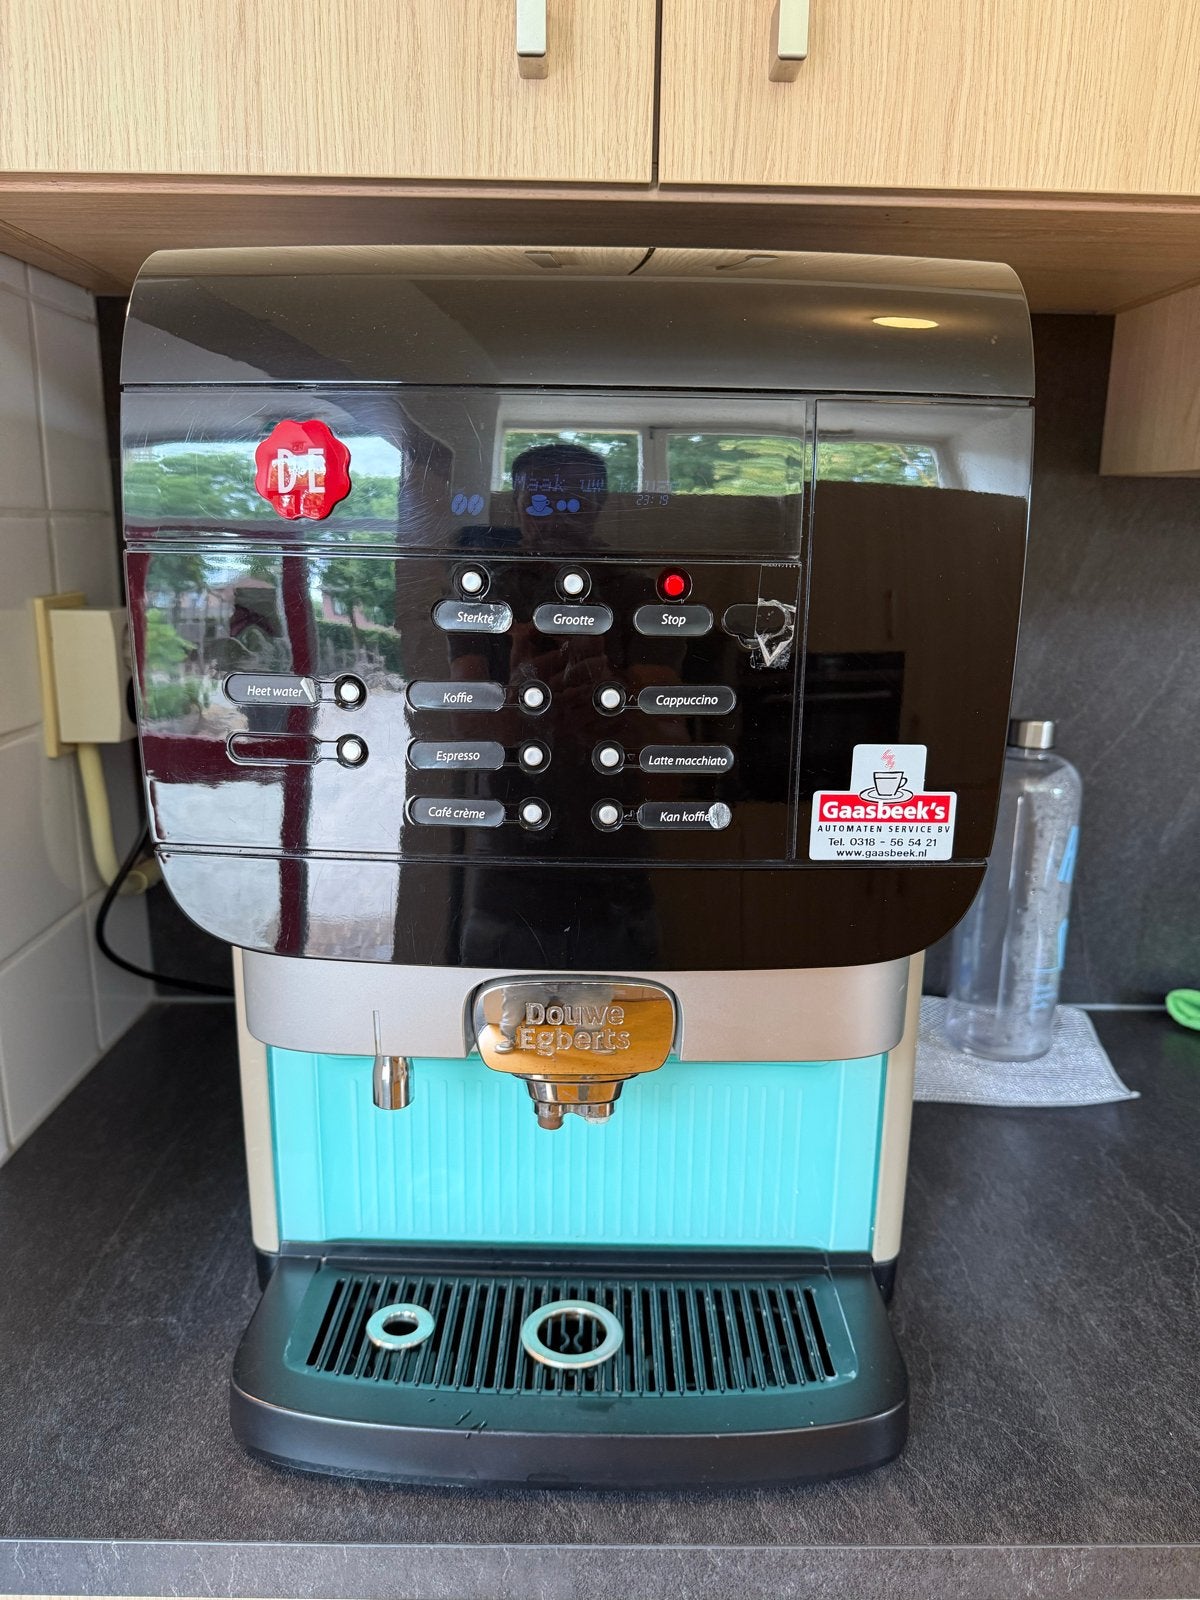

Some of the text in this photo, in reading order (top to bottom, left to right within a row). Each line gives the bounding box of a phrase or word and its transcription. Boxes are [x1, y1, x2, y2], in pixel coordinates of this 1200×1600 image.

[456, 611, 495, 625] Sterkte
[552, 612, 595, 627] Grootte
[661, 613, 687, 627] Stop
[247, 685, 304, 698] Heet water
[442, 690, 474, 704] Koffie
[655, 694, 719, 707] Cappuccino
[435, 750, 480, 763] Espresso
[648, 755, 728, 766] Latte macchiato
[428, 806, 486, 819] Café crème
[659, 810, 711, 822] Kan koffie
[822, 800, 946, 820] Gaasbeek's
[817, 824, 883, 833] AUTOMATEN
[888, 825, 933, 833] SERVICE
[828, 837, 845, 847] Tel.
[849, 837, 876, 847] 0318
[889, 838, 904, 847] 56
[907, 838, 922, 847] 54
[926, 838, 938, 847] 21
[836, 848, 928, 858] www.gaasbeek.nl
[524, 1002, 625, 1026] Douwe
[519, 1027, 631, 1056] Egberts
